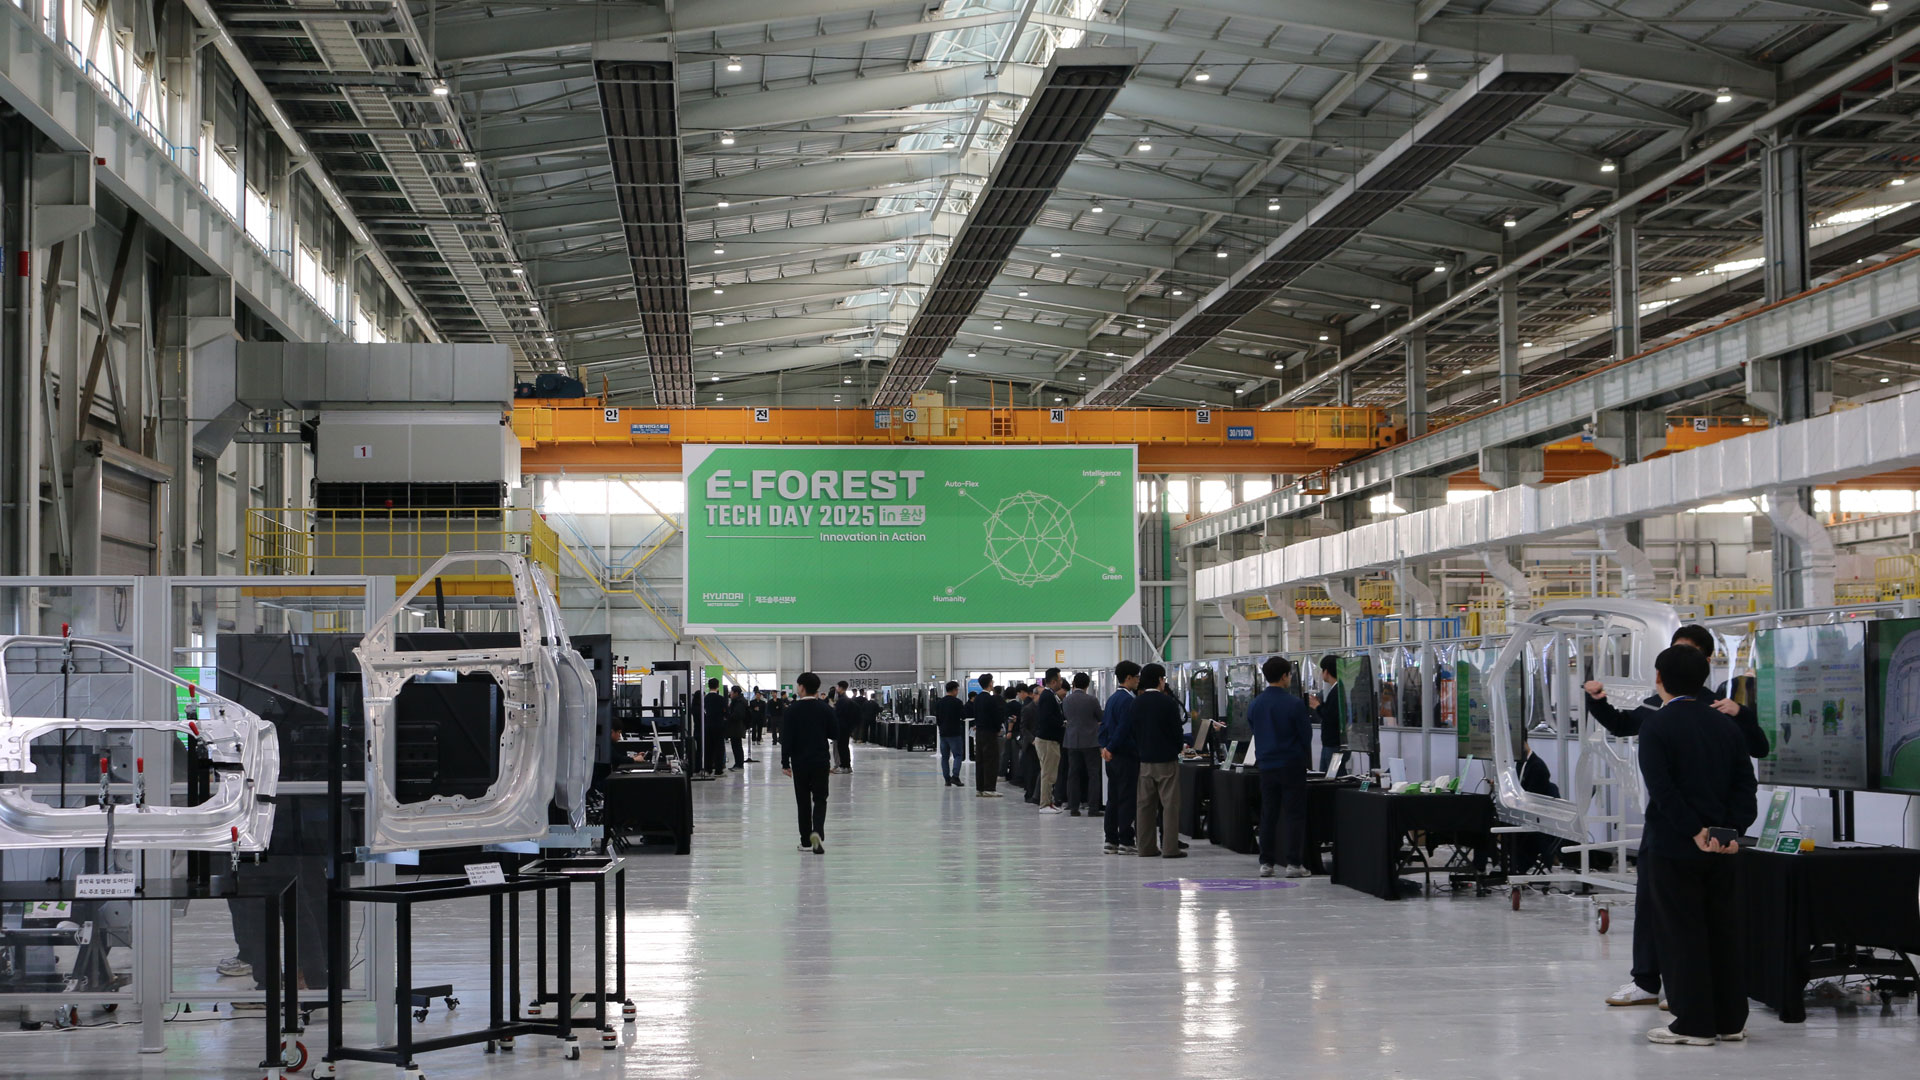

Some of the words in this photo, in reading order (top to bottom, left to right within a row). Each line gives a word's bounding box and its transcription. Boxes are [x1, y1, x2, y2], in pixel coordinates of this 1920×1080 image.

[605, 409, 618, 421] 안
[756, 409, 767, 421] 전
[1051, 410, 1063, 421] 제
[1197, 410, 1209, 422] 일
[1695, 419, 1706, 431] 전
[360, 446, 366, 457] 1
[1082, 470, 1121, 478] Intelligence
[706, 469, 925, 500] E-FOREST
[945, 480, 979, 488] Auto-Flex
[705, 505, 761, 526] TECH
[768, 505, 814, 526] DAY
[820, 505, 875, 526] 2025
[882, 508, 896, 522] in
[899, 508, 924, 522] 울산
[820, 532, 877, 542] Innovation
[880, 532, 890, 542] in
[891, 532, 926, 542] Action
[702, 592, 744, 600] HYUNDAI
[933, 595, 966, 603] Humanity
